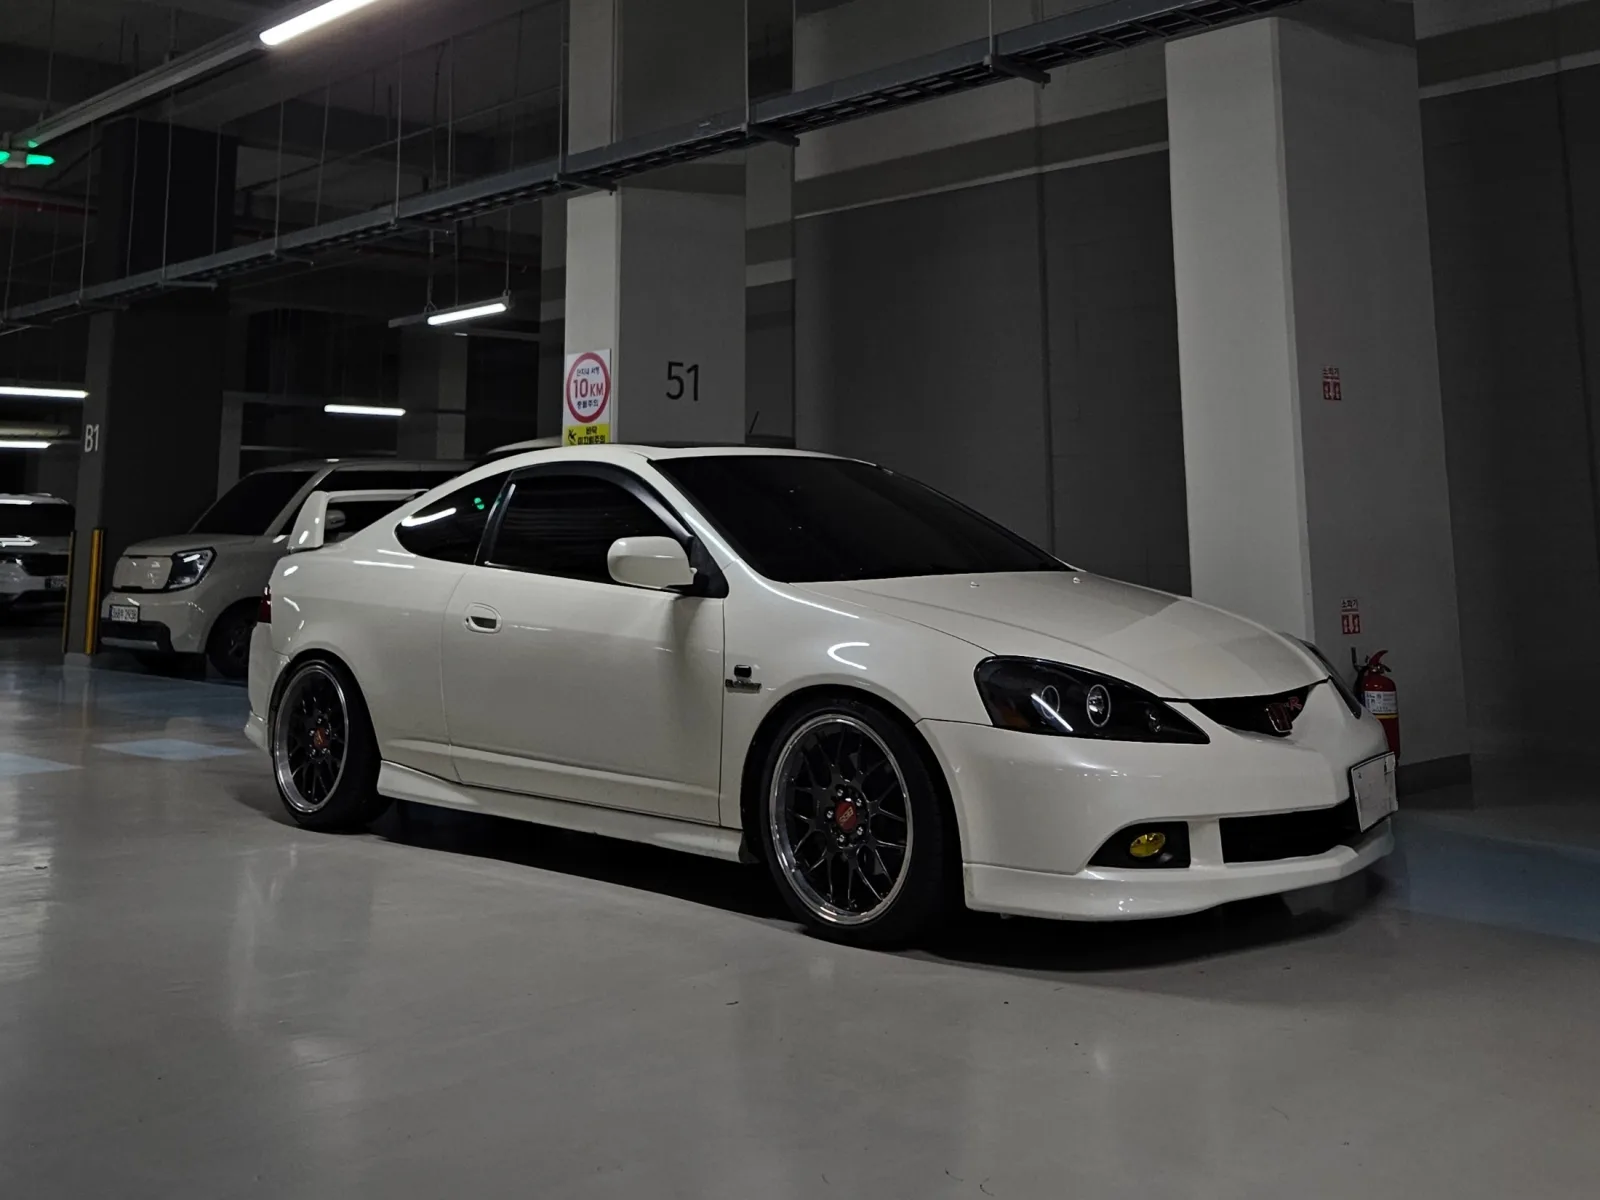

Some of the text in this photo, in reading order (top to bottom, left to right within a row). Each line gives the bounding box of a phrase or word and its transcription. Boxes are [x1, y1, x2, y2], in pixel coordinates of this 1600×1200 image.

[573, 378, 604, 398] 10 KM
[665, 361, 699, 401] 51
[85, 424, 100, 452] B1
